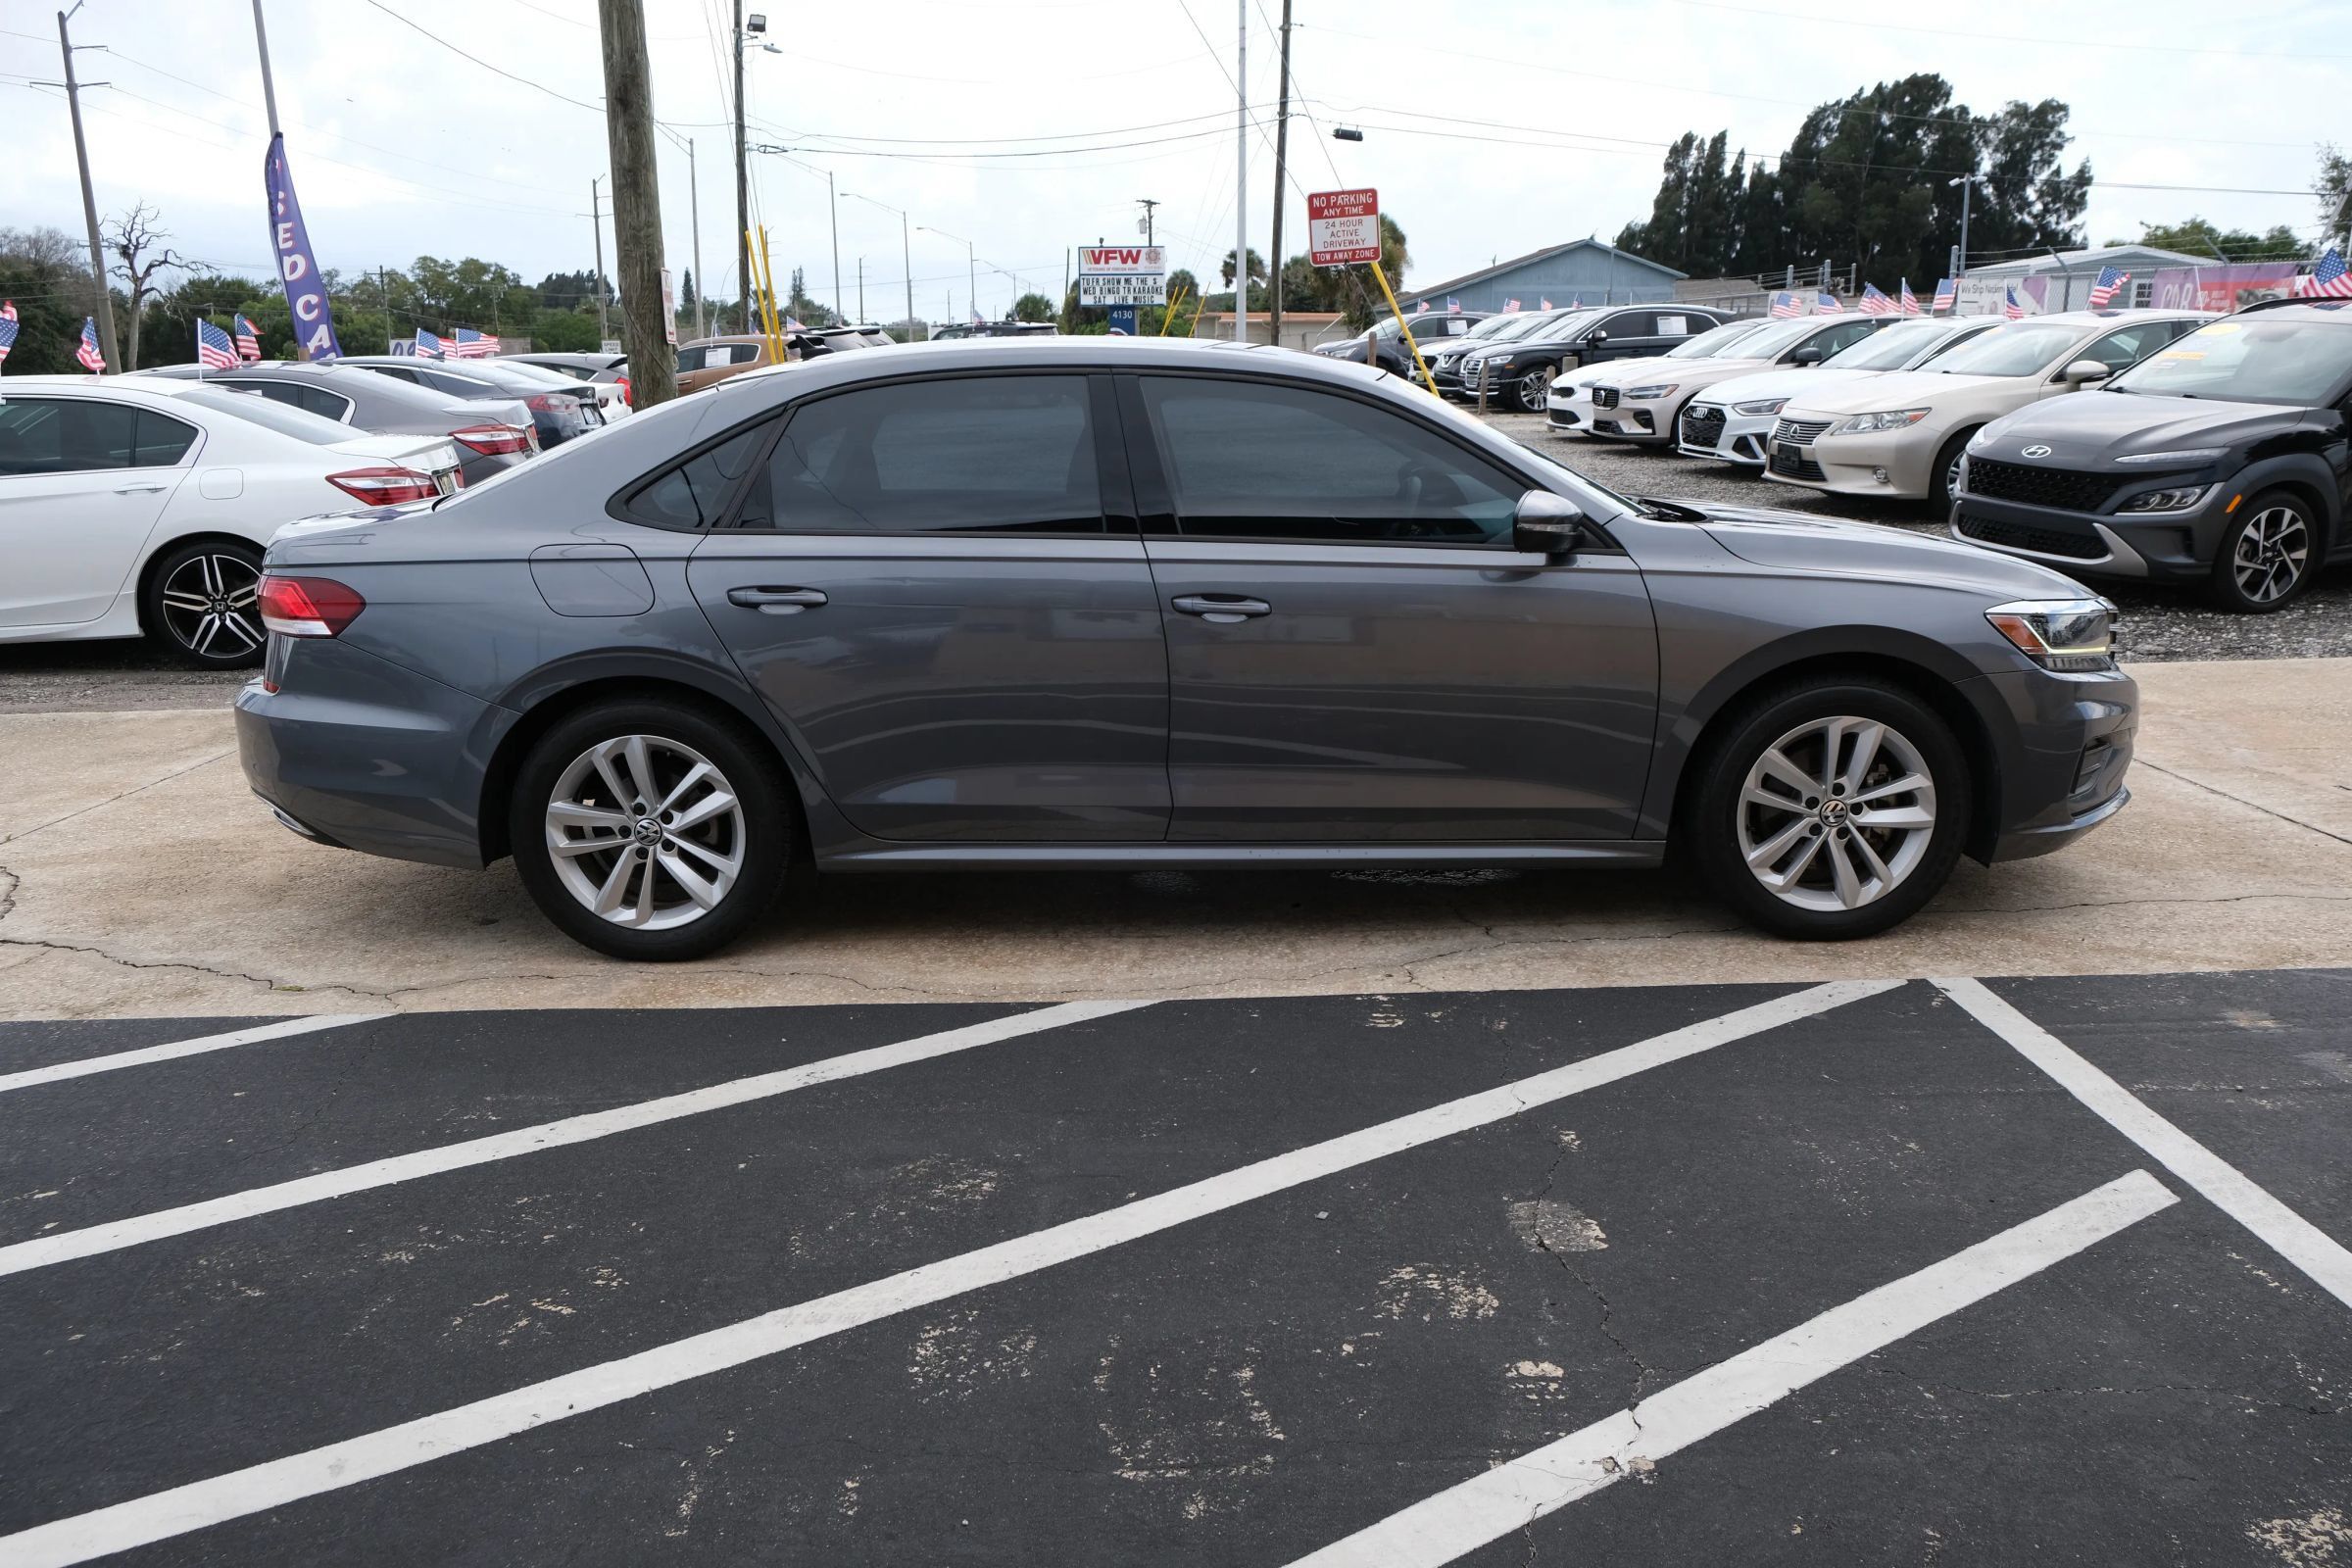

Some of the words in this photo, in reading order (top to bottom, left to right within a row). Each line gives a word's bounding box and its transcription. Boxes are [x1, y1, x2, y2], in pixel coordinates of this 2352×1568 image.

[1313, 197, 1327, 208] NO
[1330, 192, 1373, 206] PARKING
[1323, 208, 1342, 218] ANY
[1344, 206, 1364, 216] TIME
[1339, 219, 1363, 228] HOUR
[1329, 229, 1360, 239] ACTIVE
[1323, 238, 1366, 249] DRIVEWAY
[1090, 249, 1142, 265] VFW
[1316, 253, 1331, 262] TOW
[1333, 251, 1352, 261] AWAY
[1354, 249, 1375, 259] ZONE
[1102, 277, 1121, 286] SHOW
[1133, 286, 1163, 295] KARAOKE
[1112, 311, 1133, 319] 4130
[296, 294, 336, 360] CA
